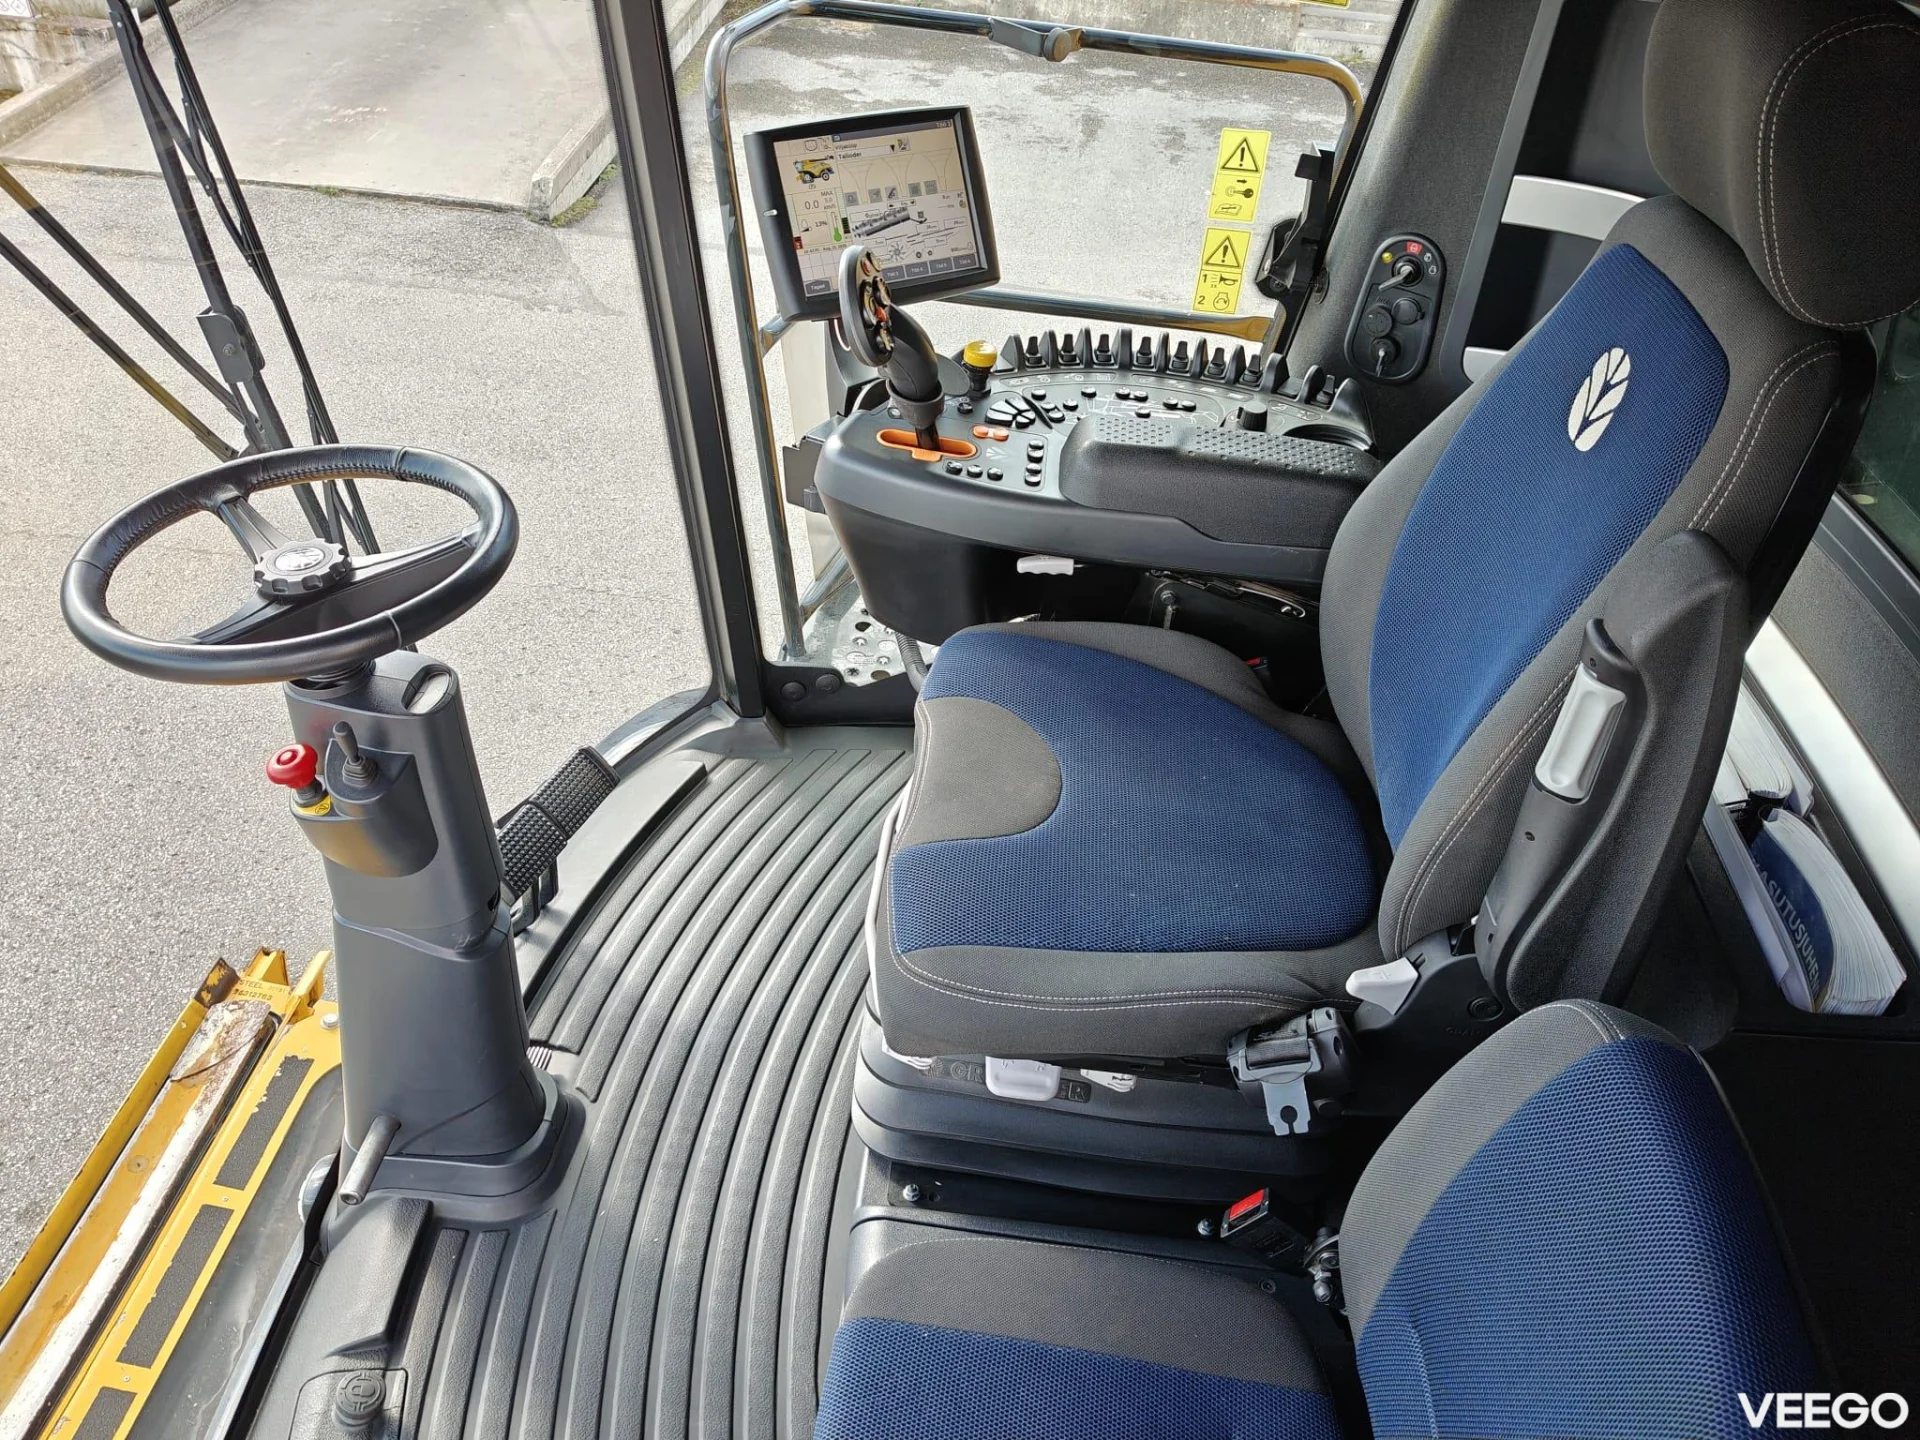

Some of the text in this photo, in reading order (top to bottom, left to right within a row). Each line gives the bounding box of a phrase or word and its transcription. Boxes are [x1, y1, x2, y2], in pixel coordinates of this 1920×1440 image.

[804, 200, 819, 210] 0.0
[1202, 273, 1208, 283] 1
[1197, 295, 1206, 305] 2
